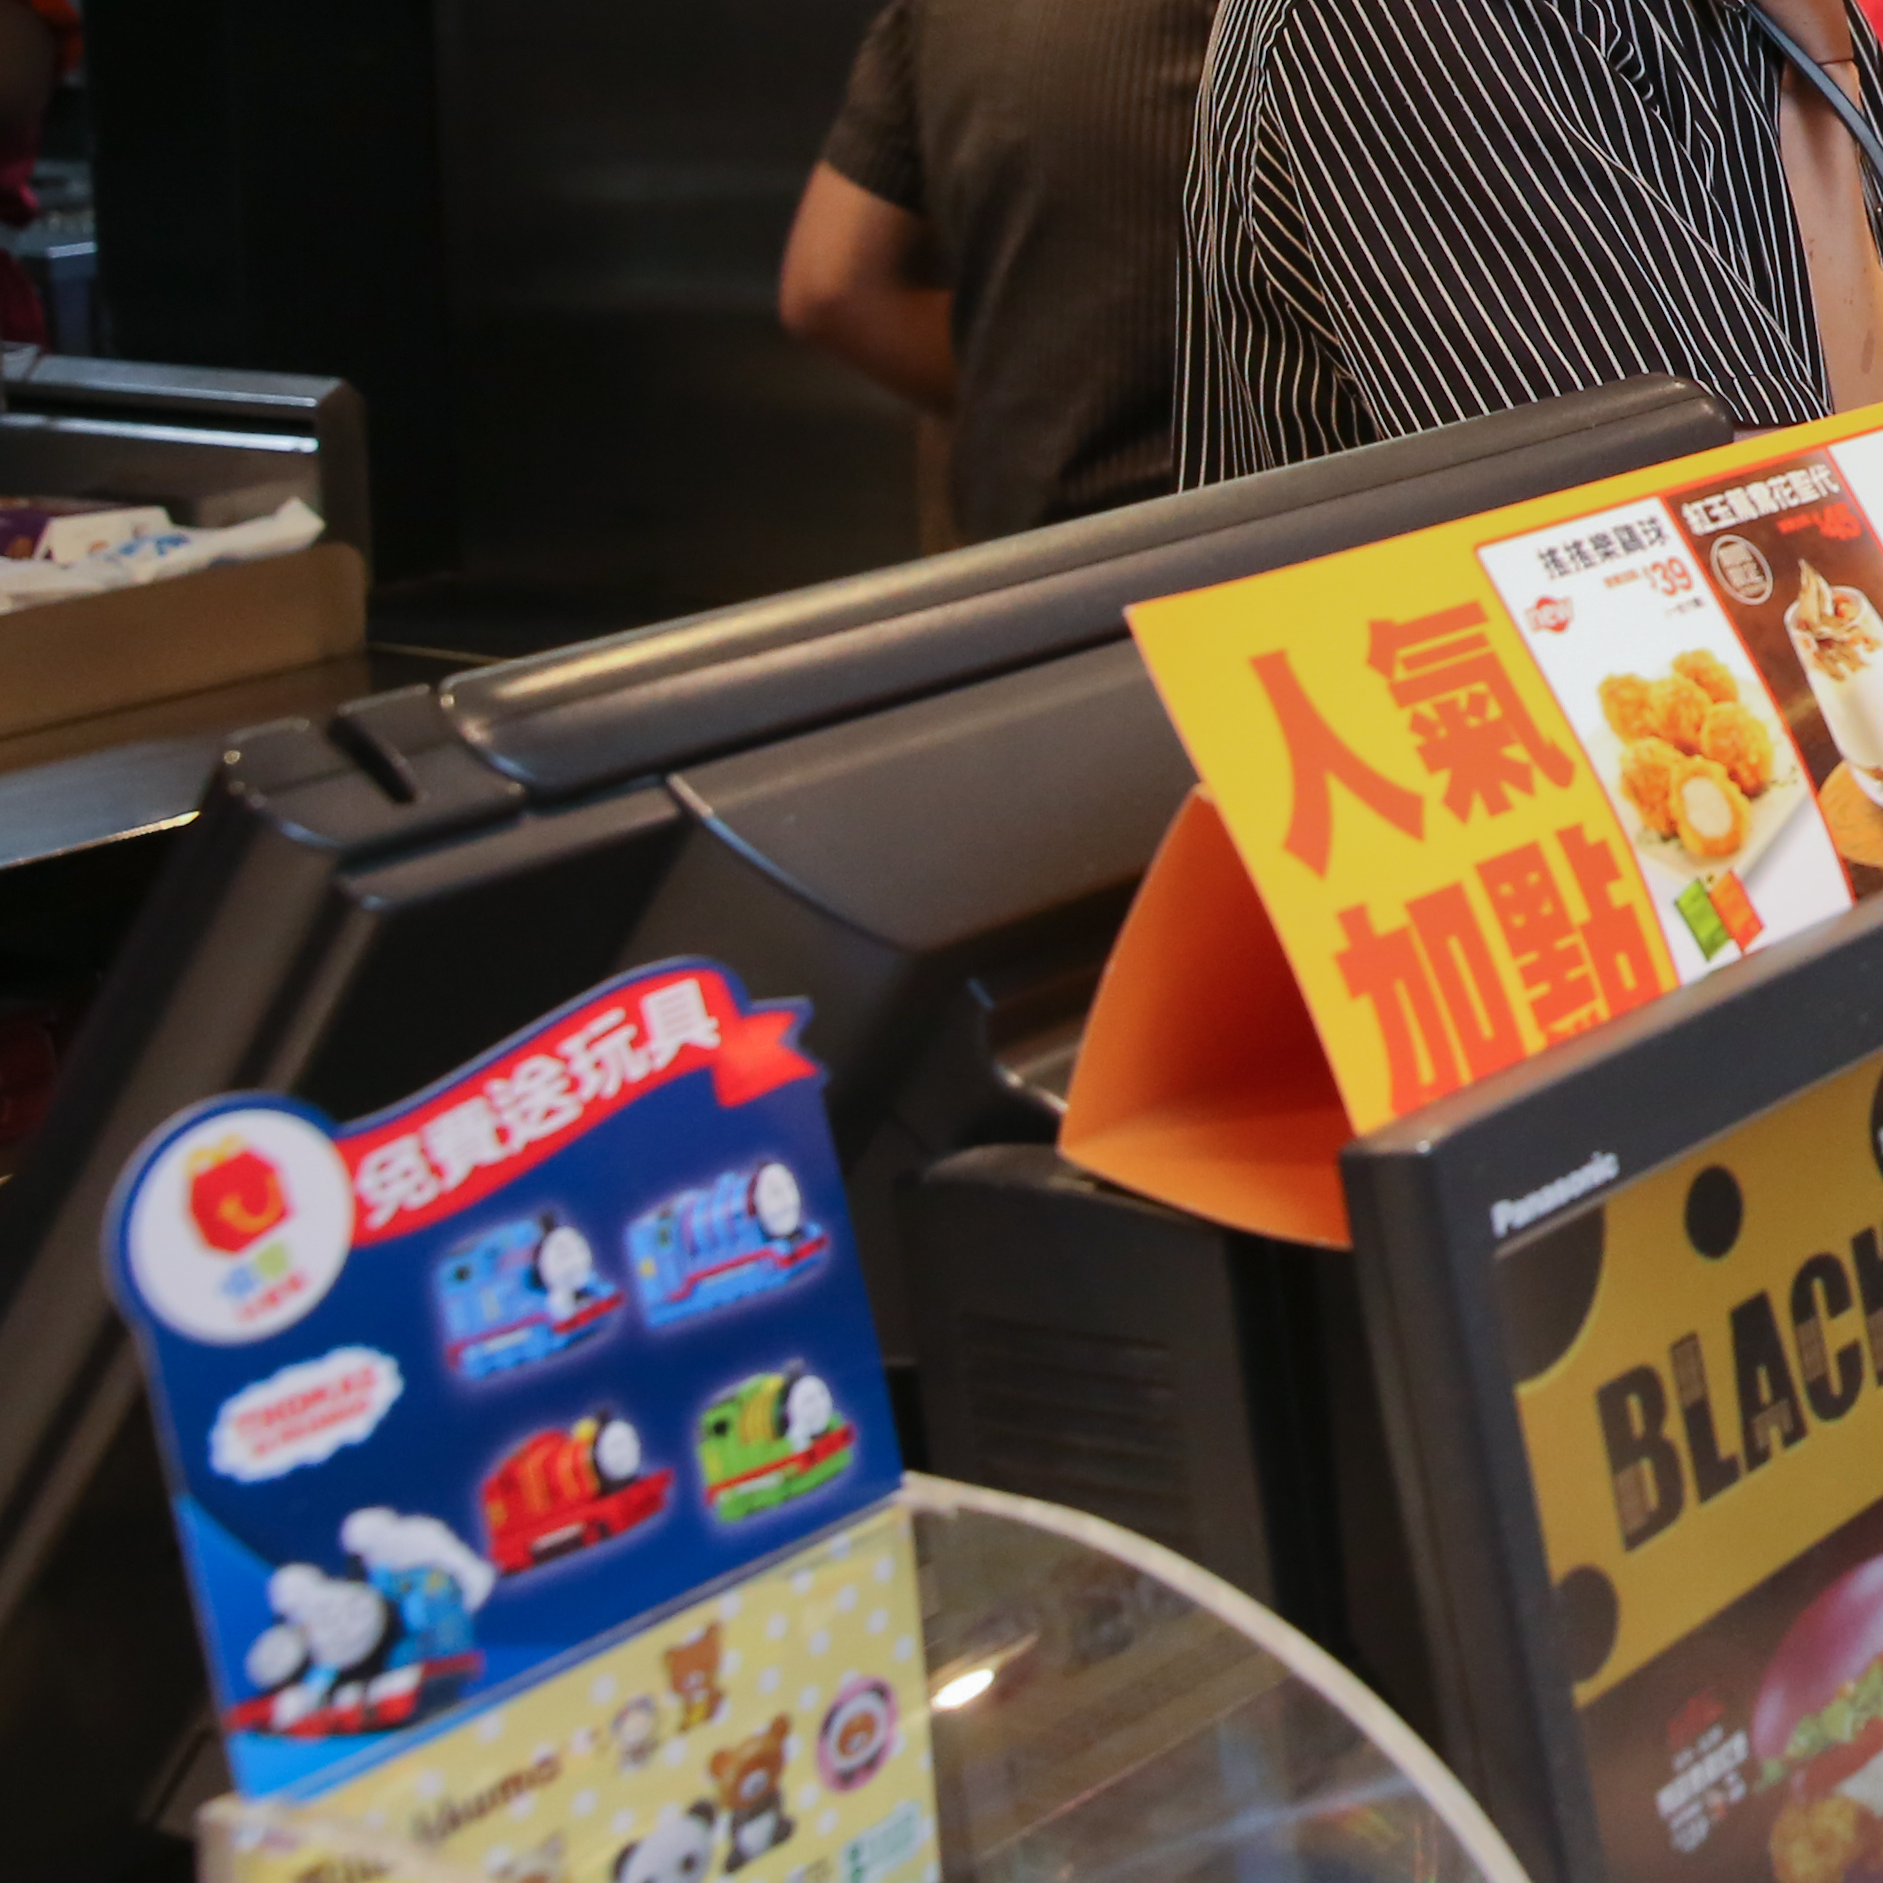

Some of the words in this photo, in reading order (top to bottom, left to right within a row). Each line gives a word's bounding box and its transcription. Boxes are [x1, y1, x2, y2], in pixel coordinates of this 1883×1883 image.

[1644, 557, 1693, 596] $39
[1250, 598, 1578, 880] 人氣
[1334, 823, 1677, 1115] 加點
[355, 979, 720, 1227] 免費送玩具
[1490, 1148, 1622, 1238] Panasonic
